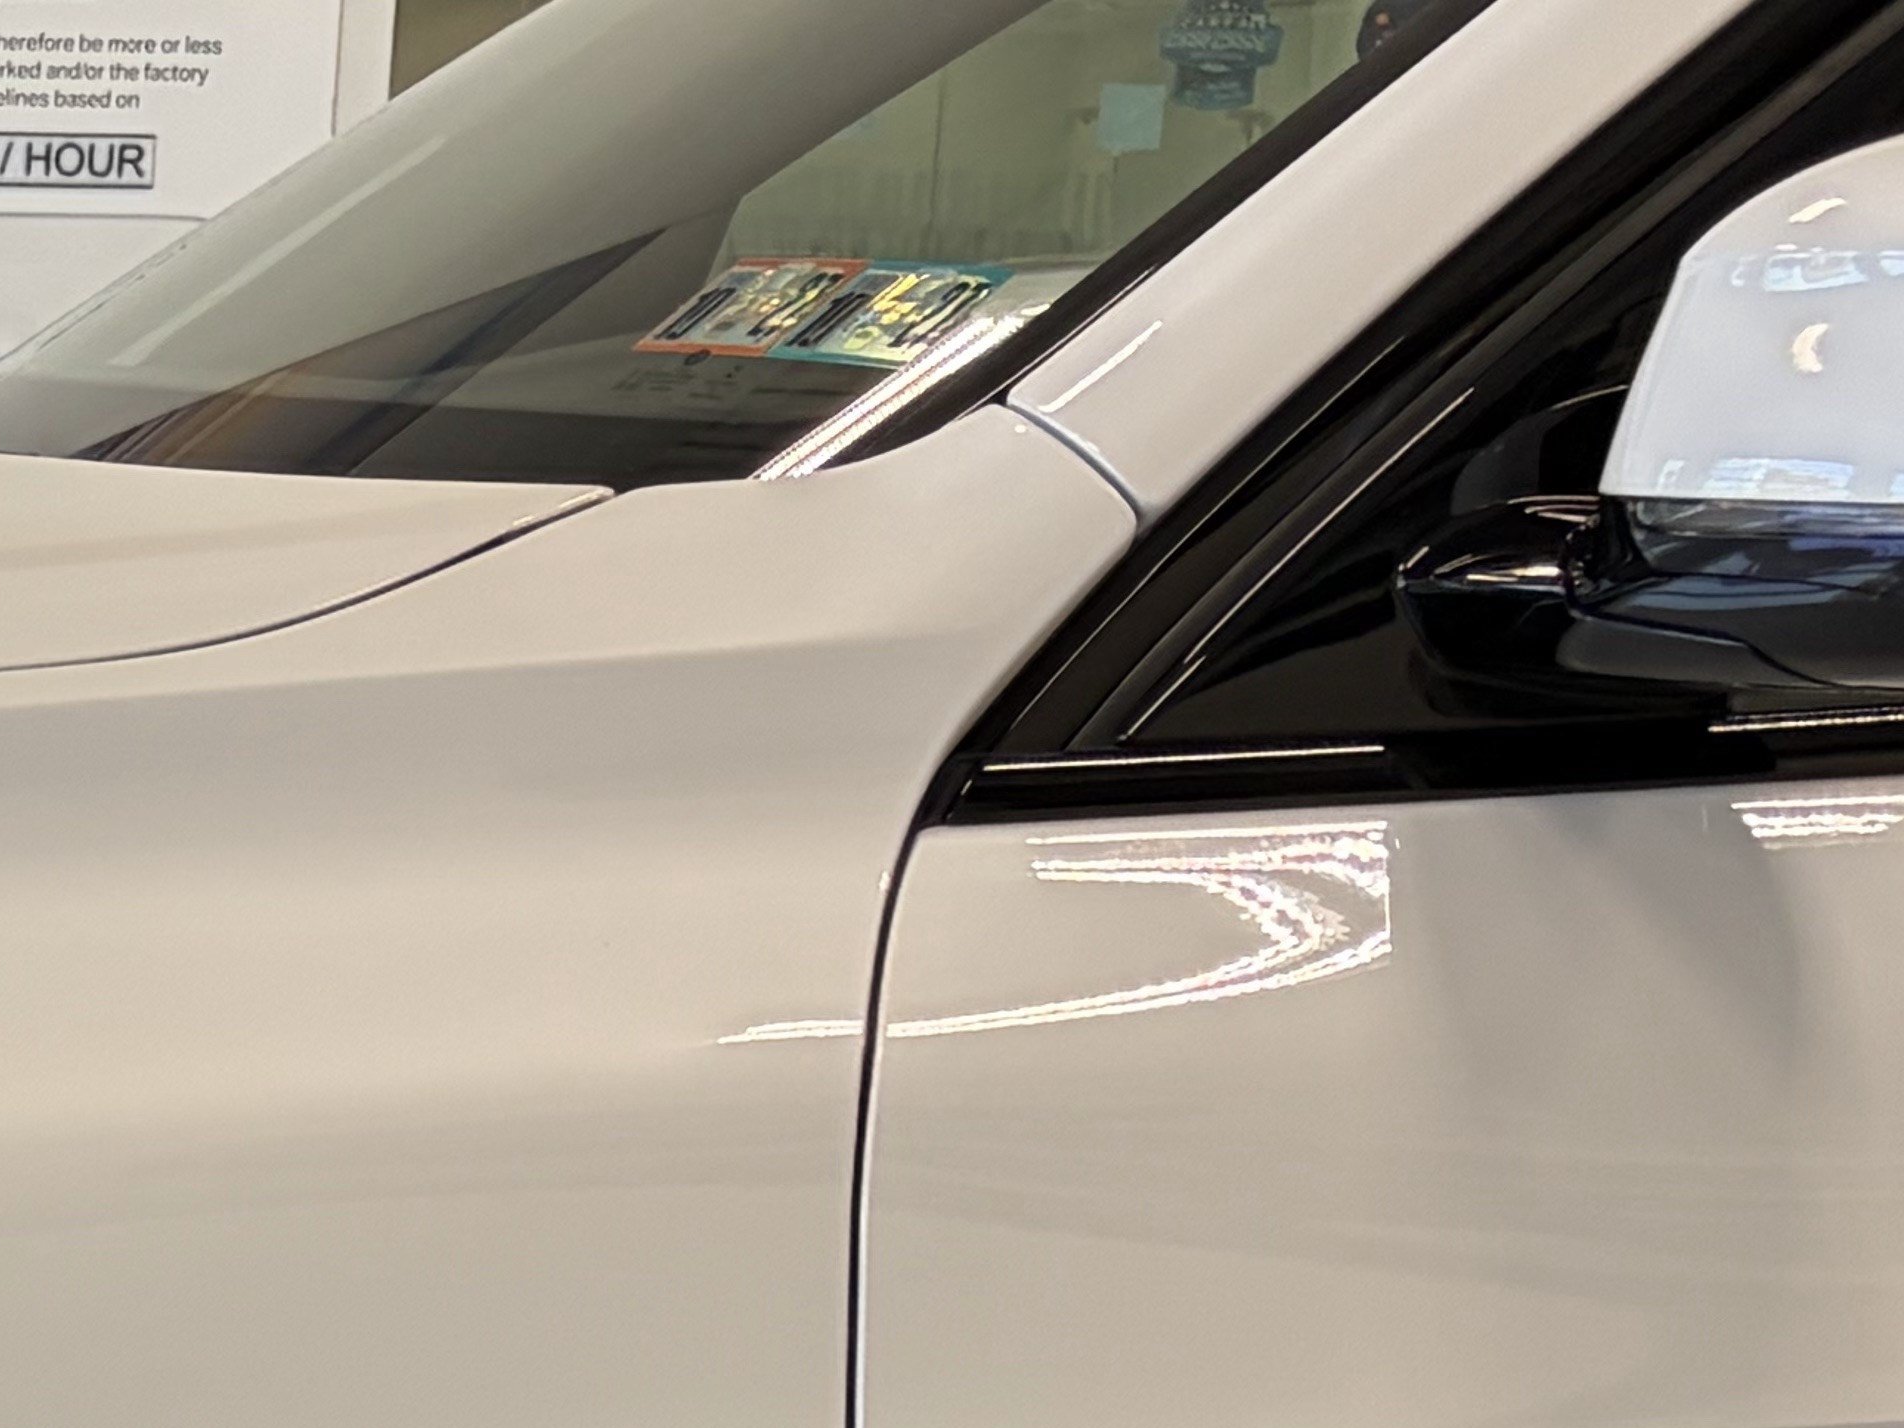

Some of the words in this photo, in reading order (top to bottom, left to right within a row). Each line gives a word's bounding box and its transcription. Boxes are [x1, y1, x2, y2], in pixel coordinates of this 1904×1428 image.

[78, 34, 102, 53] be
[107, 38, 156, 55] more
[161, 39, 180, 55] or
[185, 36, 223, 55] less
[46, 64, 105, 82] and/or
[109, 65, 140, 82] the
[144, 66, 209, 87] factory
[54, 90, 112, 109] based
[115, 94, 140, 111] on
[24, 142, 146, 178] HOUR
